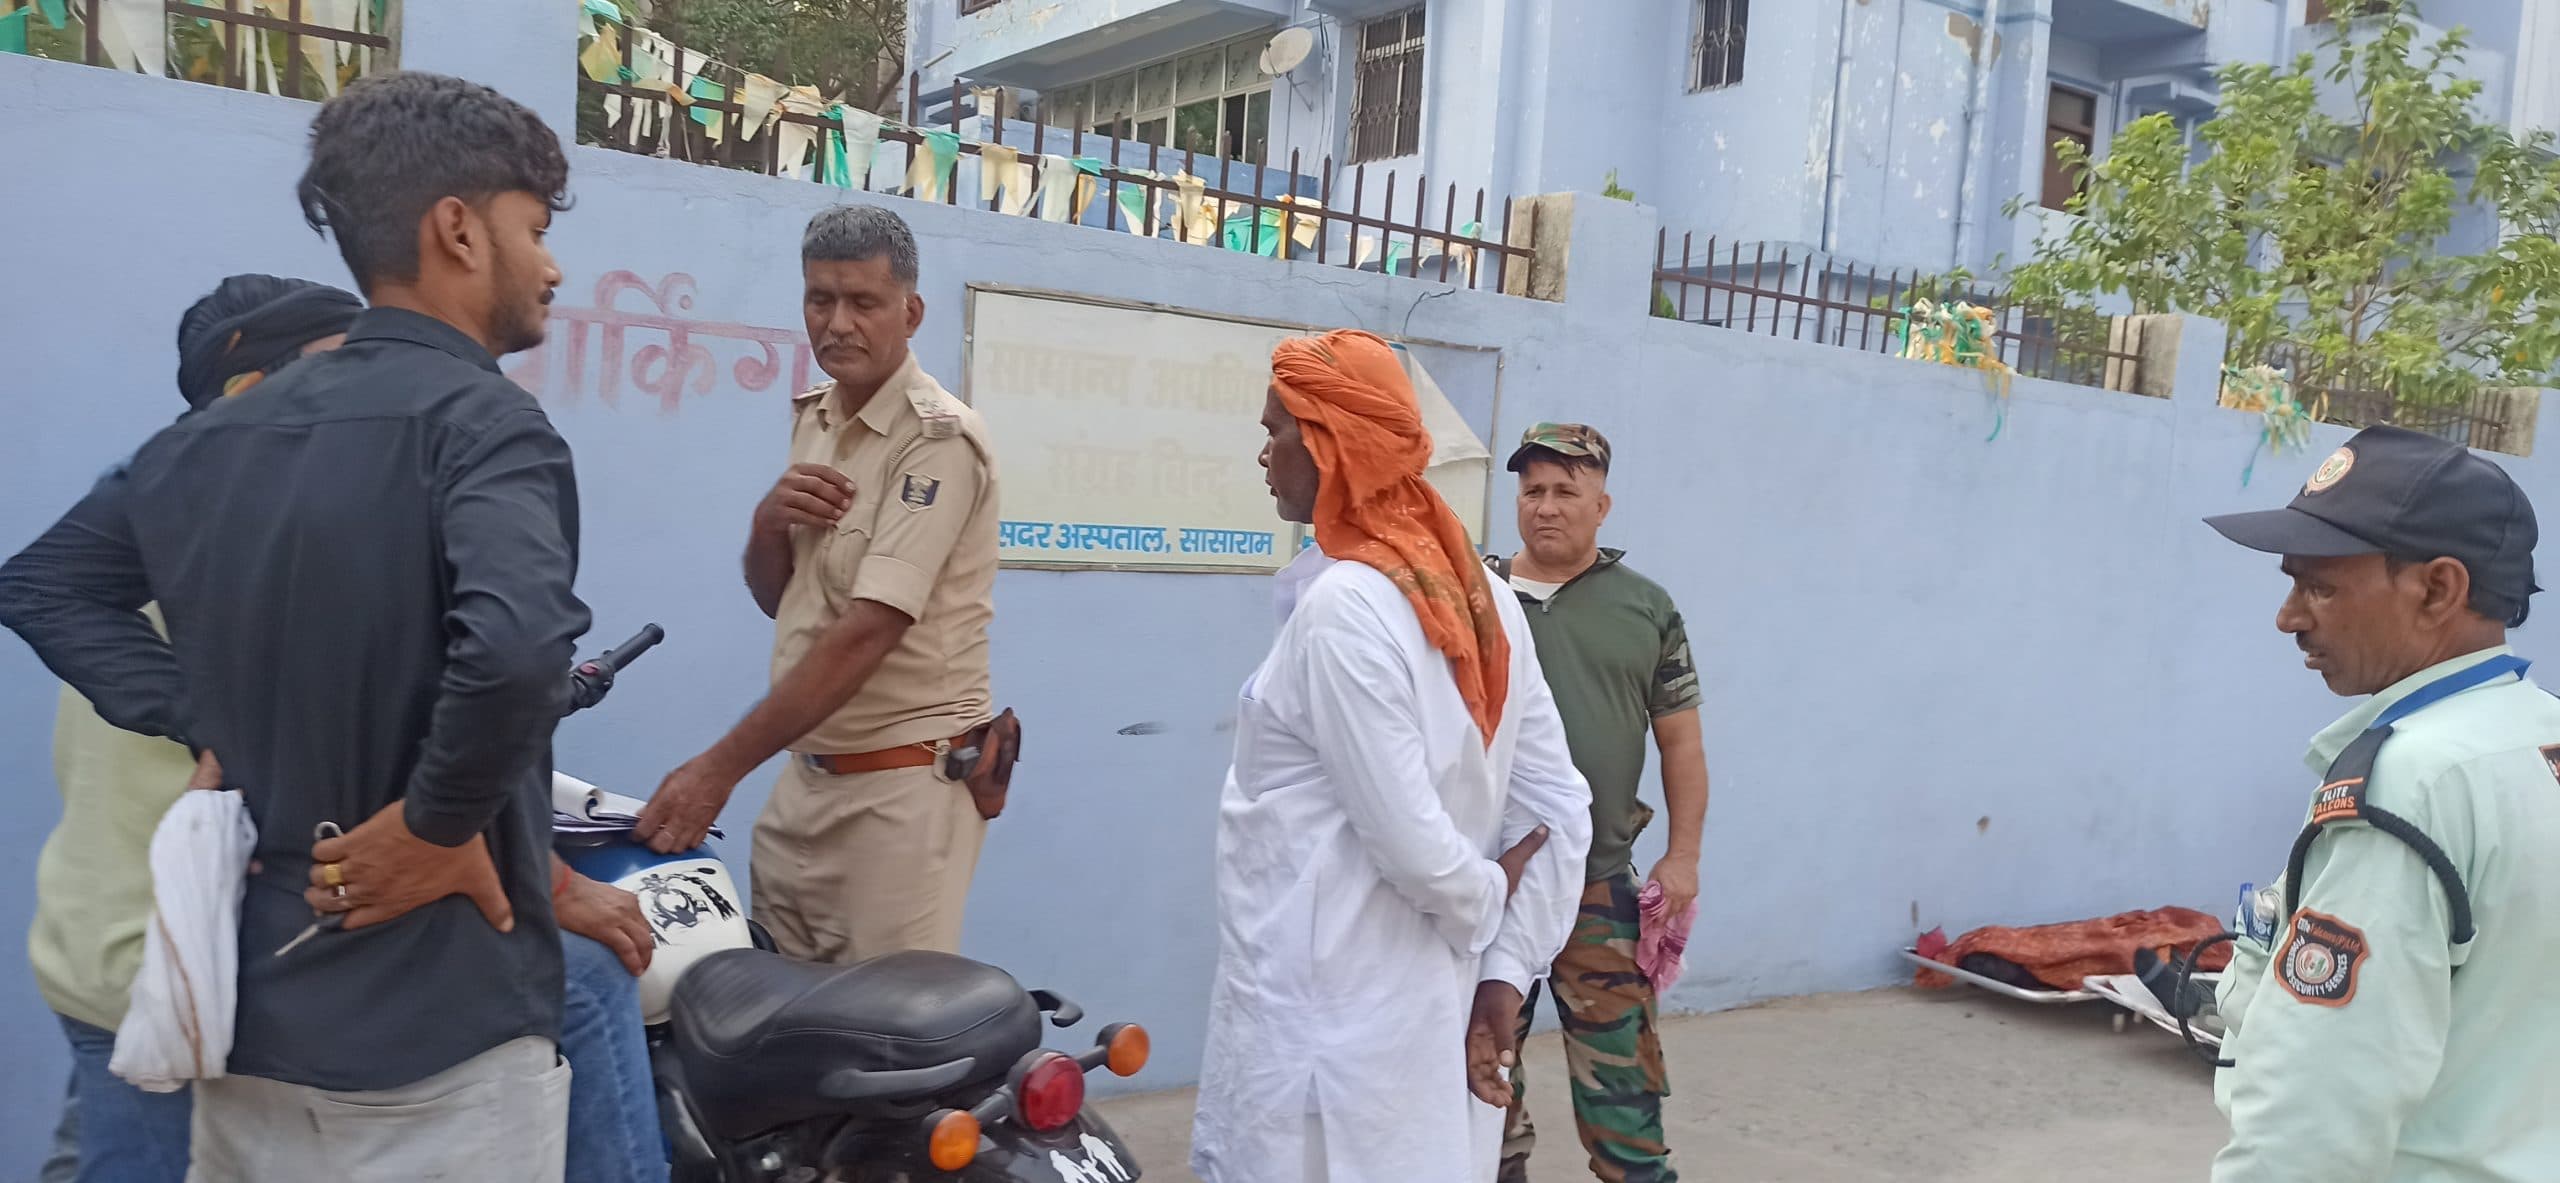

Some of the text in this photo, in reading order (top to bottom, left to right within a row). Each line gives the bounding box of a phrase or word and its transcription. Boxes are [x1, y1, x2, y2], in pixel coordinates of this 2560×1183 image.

[999, 520, 1054, 549] सदर
[1179, 527, 1274, 556] सासाराम
[2322, 785, 2349, 802] ELITE
[2288, 976, 2326, 996] SECURITY
